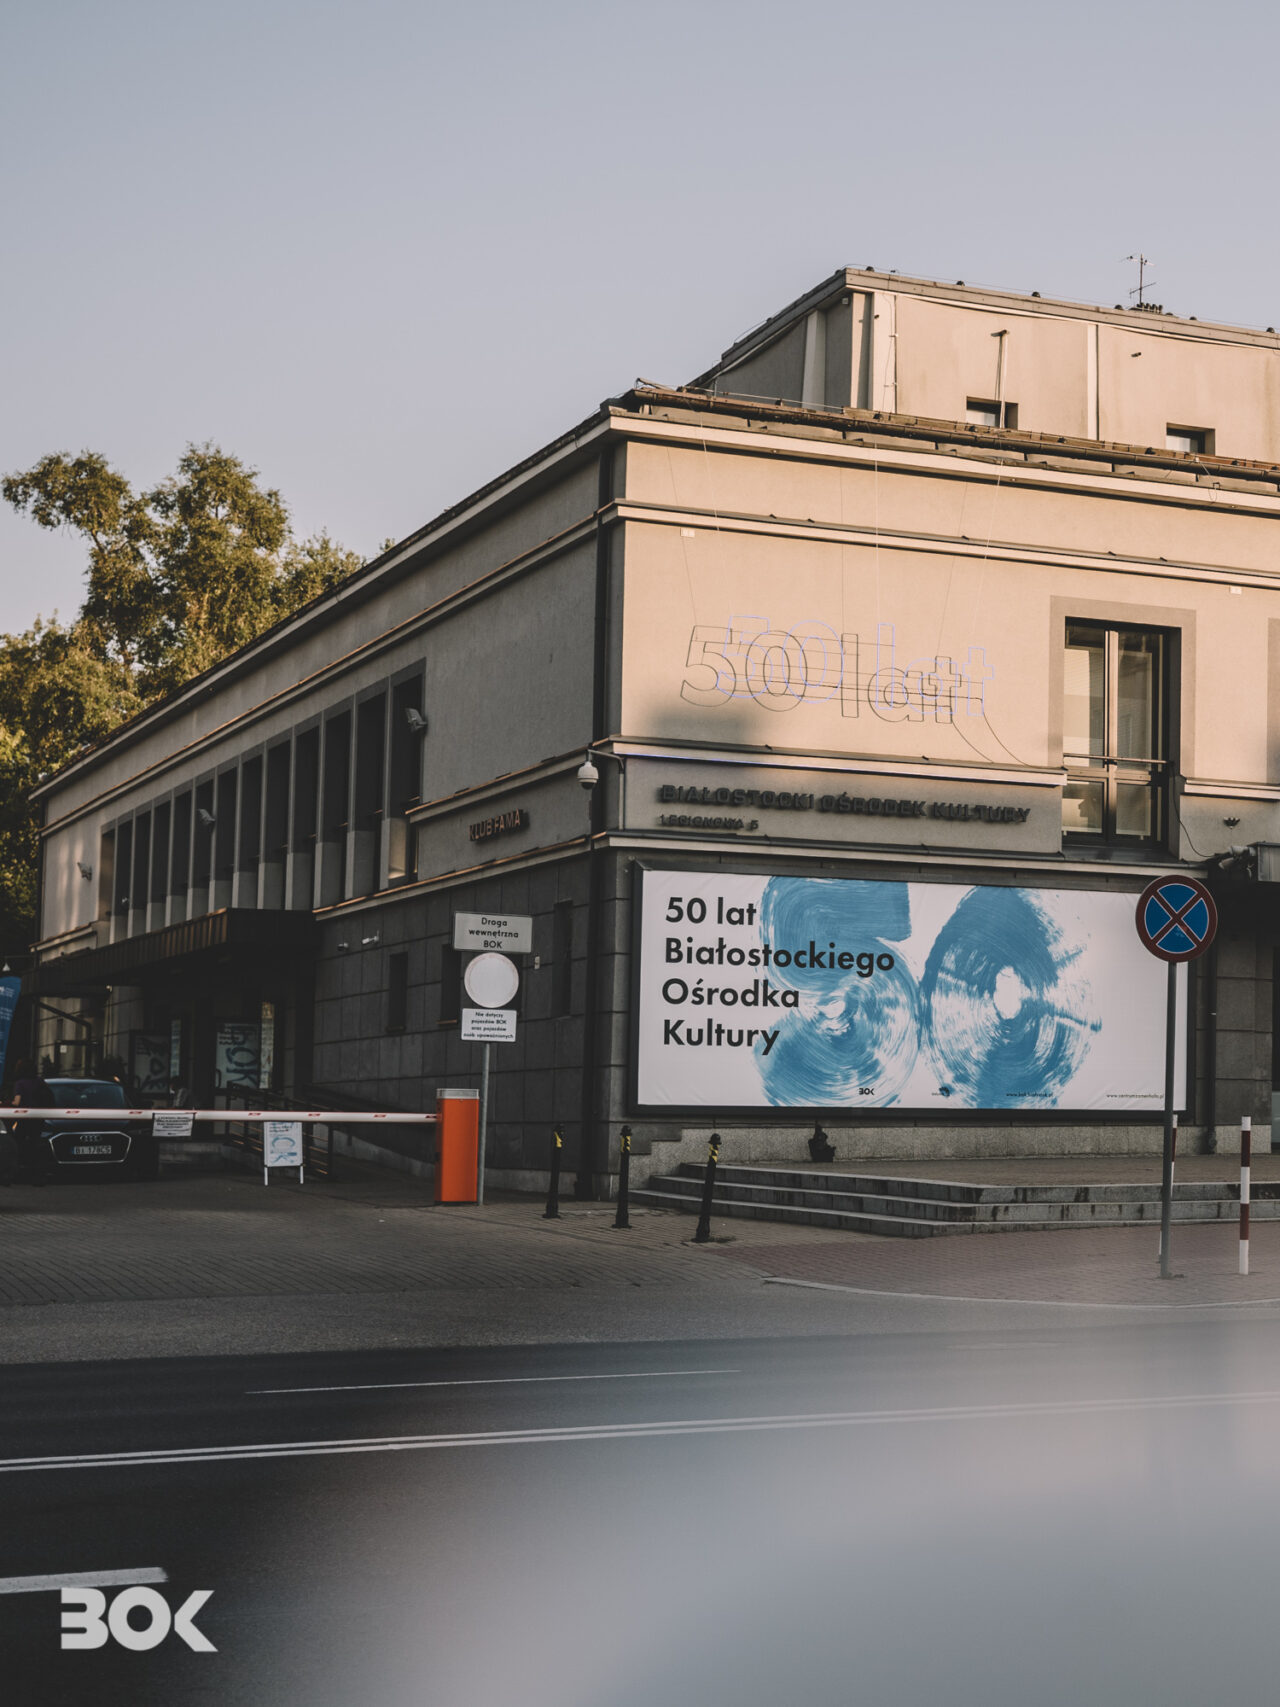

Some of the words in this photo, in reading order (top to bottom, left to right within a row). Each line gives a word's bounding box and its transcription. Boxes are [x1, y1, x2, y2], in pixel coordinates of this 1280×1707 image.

[660, 784, 814, 811] BIAŁOSTOCKI
[820, 791, 927, 818] OŚRODEK
[932, 801, 1031, 823] KULTURY
[468, 816, 493, 841] KLUB
[494, 808, 521, 833] FAMA
[749, 819, 759, 831] 5
[481, 917, 508, 928] Droga
[665, 897, 707, 924] 50
[717, 897, 757, 926] lat
[468, 928, 519, 939] wewnętrzna
[483, 940, 503, 949] BOK
[665, 936, 895, 978] Białostockiego
[662, 978, 799, 1008] Ośrodka
[752, 875, 1102, 1108] 50
[663, 1018, 780, 1056] Kultury
[858, 1087, 874, 1096] BOK
